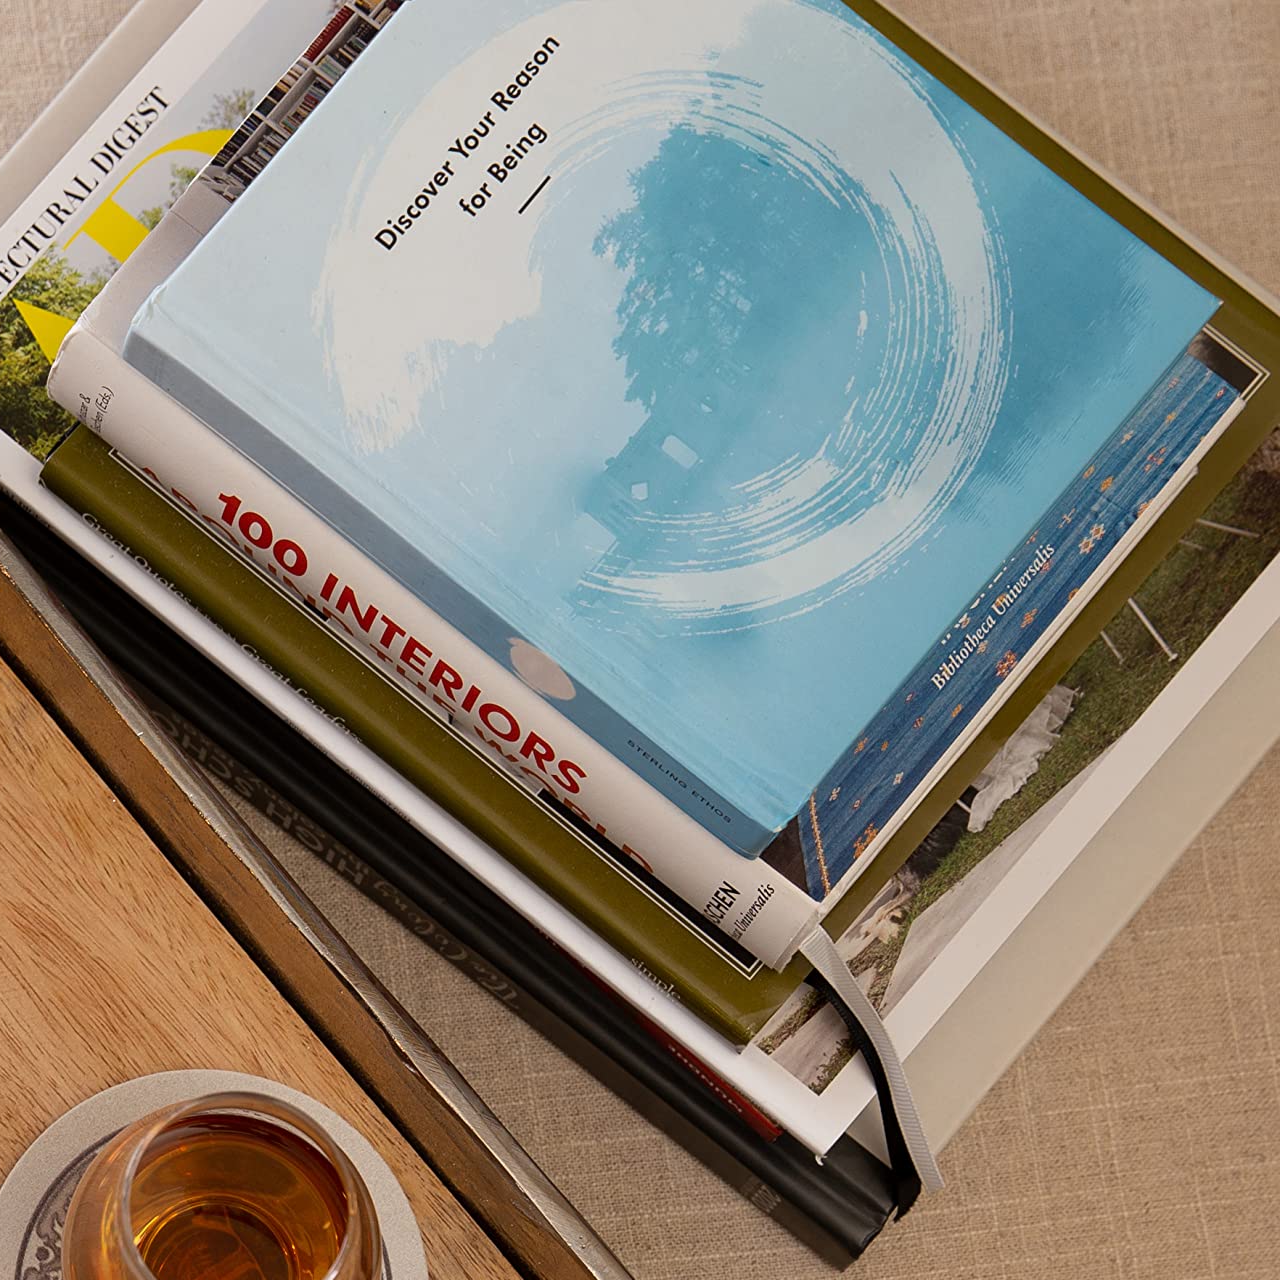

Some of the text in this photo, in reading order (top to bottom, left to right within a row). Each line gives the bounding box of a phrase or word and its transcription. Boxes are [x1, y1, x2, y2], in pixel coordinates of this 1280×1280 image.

[88, 85, 170, 175] DIGEST
[374, 34, 561, 251] Discover Your Reason
[459, 122, 548, 217] for Being
[217, 492, 308, 578] 100
[319, 572, 588, 795] INTERIORS
[930, 613, 997, 691] Bibliotheca
[990, 542, 1056, 617] Universalis
[153, 709, 253, 798] SCHO
[627, 739, 732, 824] STERLING ETHOS
[703, 880, 741, 925] SCHEN
[733, 883, 775, 932] Universalis
